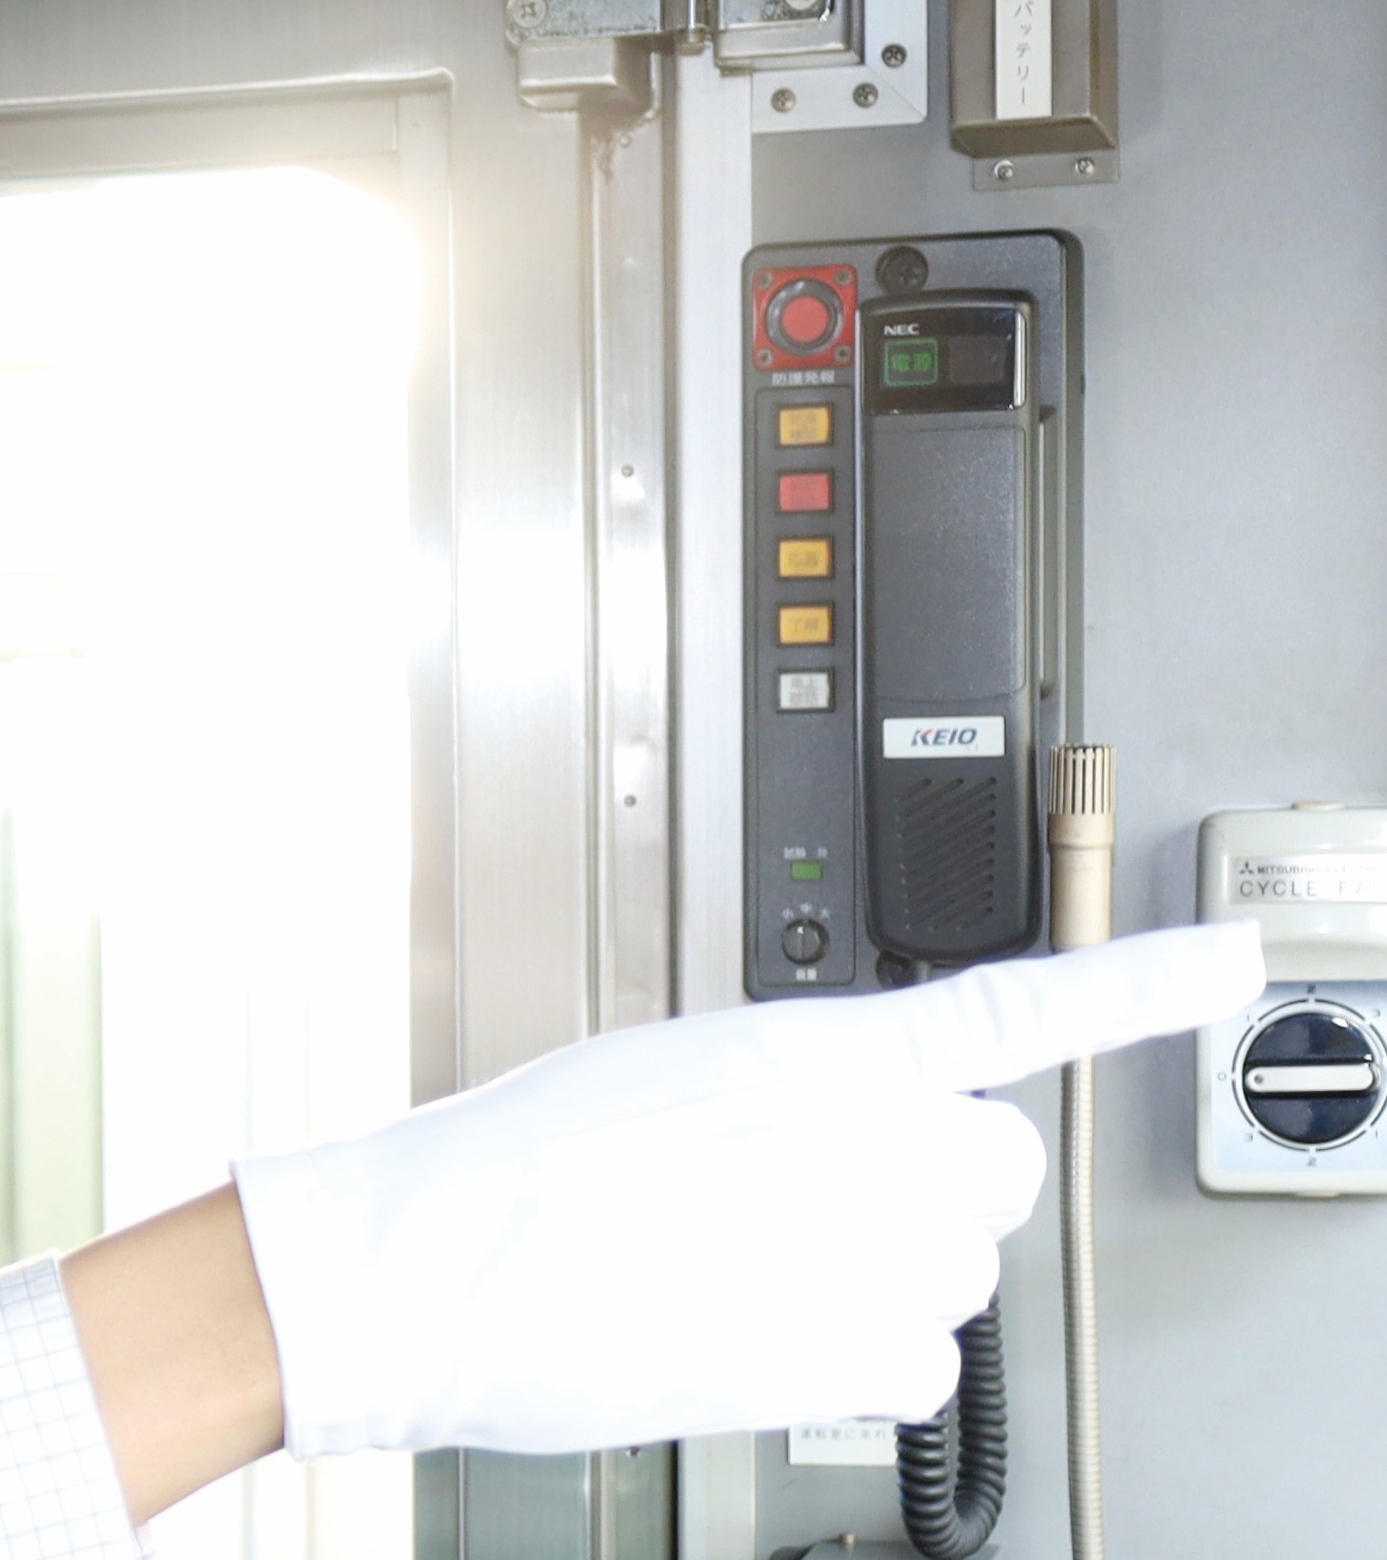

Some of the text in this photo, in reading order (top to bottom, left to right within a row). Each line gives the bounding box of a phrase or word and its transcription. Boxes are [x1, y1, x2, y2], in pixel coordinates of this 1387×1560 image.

[884, 323, 920, 336] NEC
[911, 728, 977, 747] KEIO
[1238, 880, 1318, 898] CYCLE
